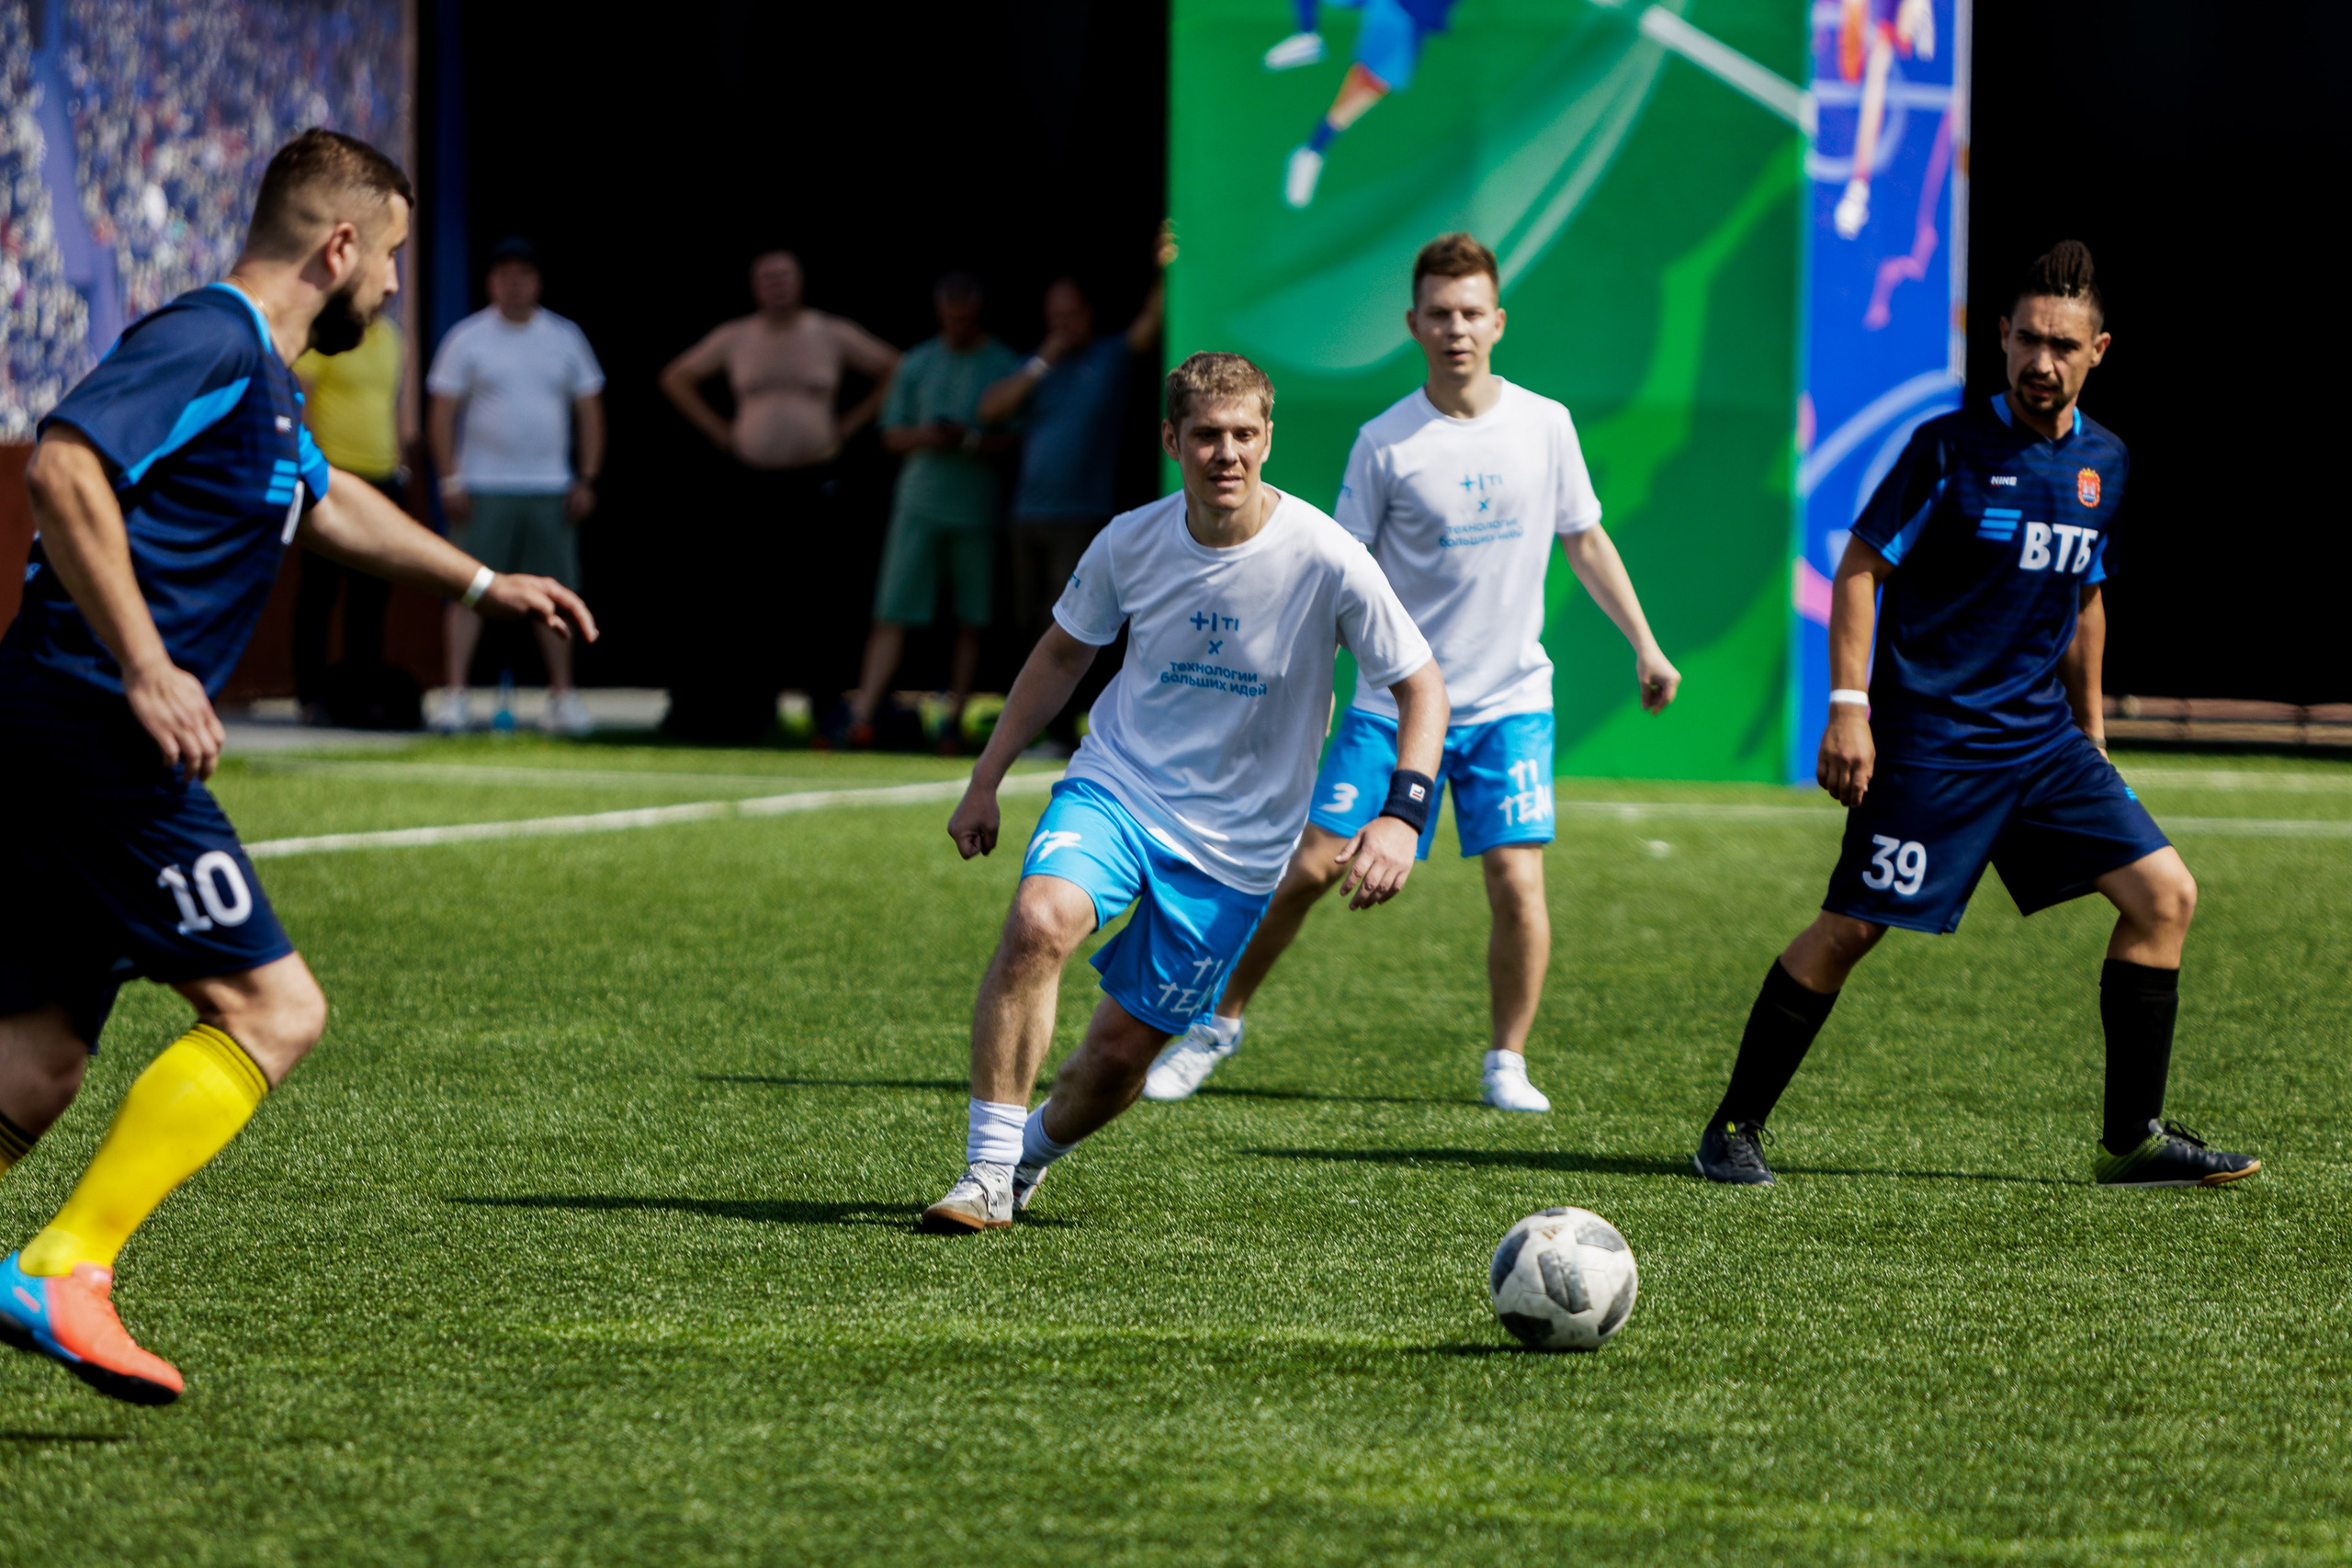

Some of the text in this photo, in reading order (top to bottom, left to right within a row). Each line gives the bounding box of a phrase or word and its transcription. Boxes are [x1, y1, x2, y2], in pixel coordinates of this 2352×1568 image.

[2018, 521, 2099, 574] ВТБ
[1160, 671, 1267, 697] больших идей
[1170, 661, 1258, 682] технологии
[1318, 782, 1359, 813] 3
[1862, 834, 1928, 896] 39
[156, 850, 253, 936] 10
